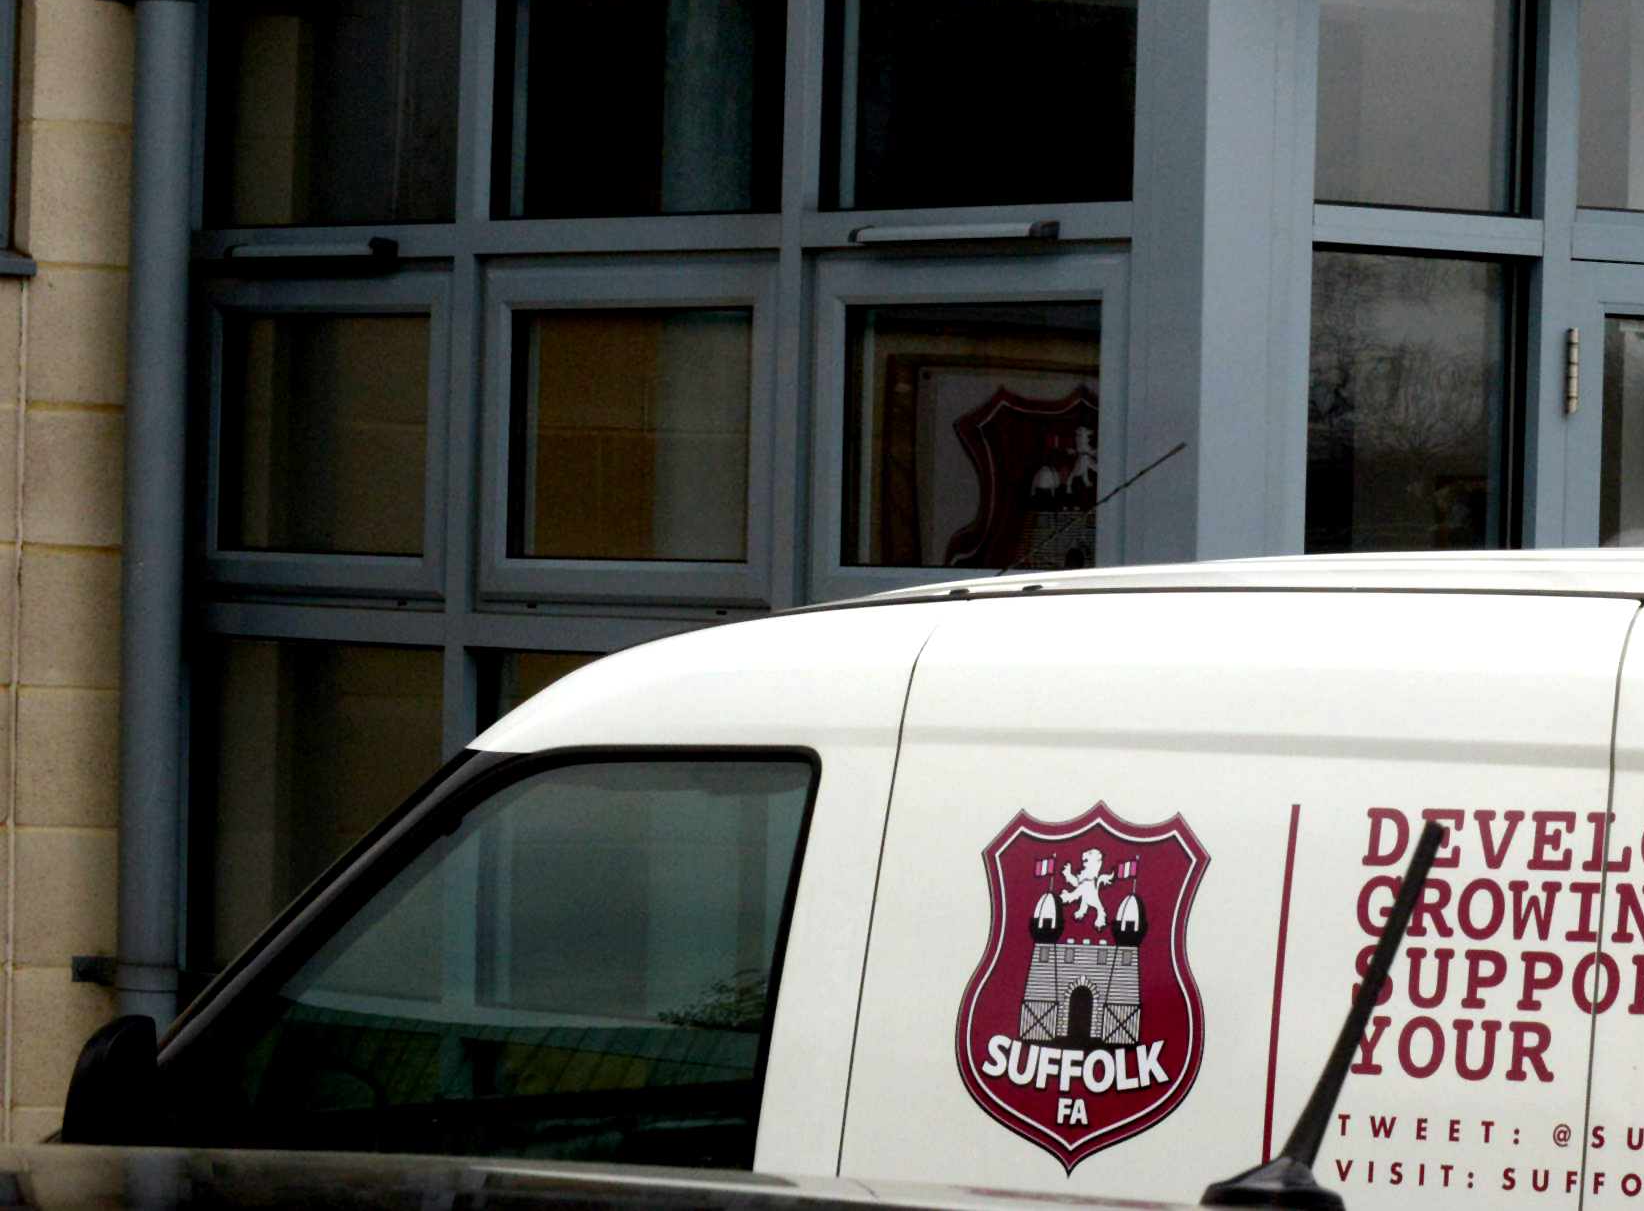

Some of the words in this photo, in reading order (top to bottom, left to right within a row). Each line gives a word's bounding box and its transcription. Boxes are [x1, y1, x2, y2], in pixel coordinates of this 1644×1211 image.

[981, 1034, 1171, 1094] SUFFOLK
[1350, 1015, 1556, 1083] YOUR
[1056, 1097, 1089, 1126] FA
[1337, 1113, 1521, 1145] TWEET:
[1335, 1159, 1474, 1190] VISIT:
